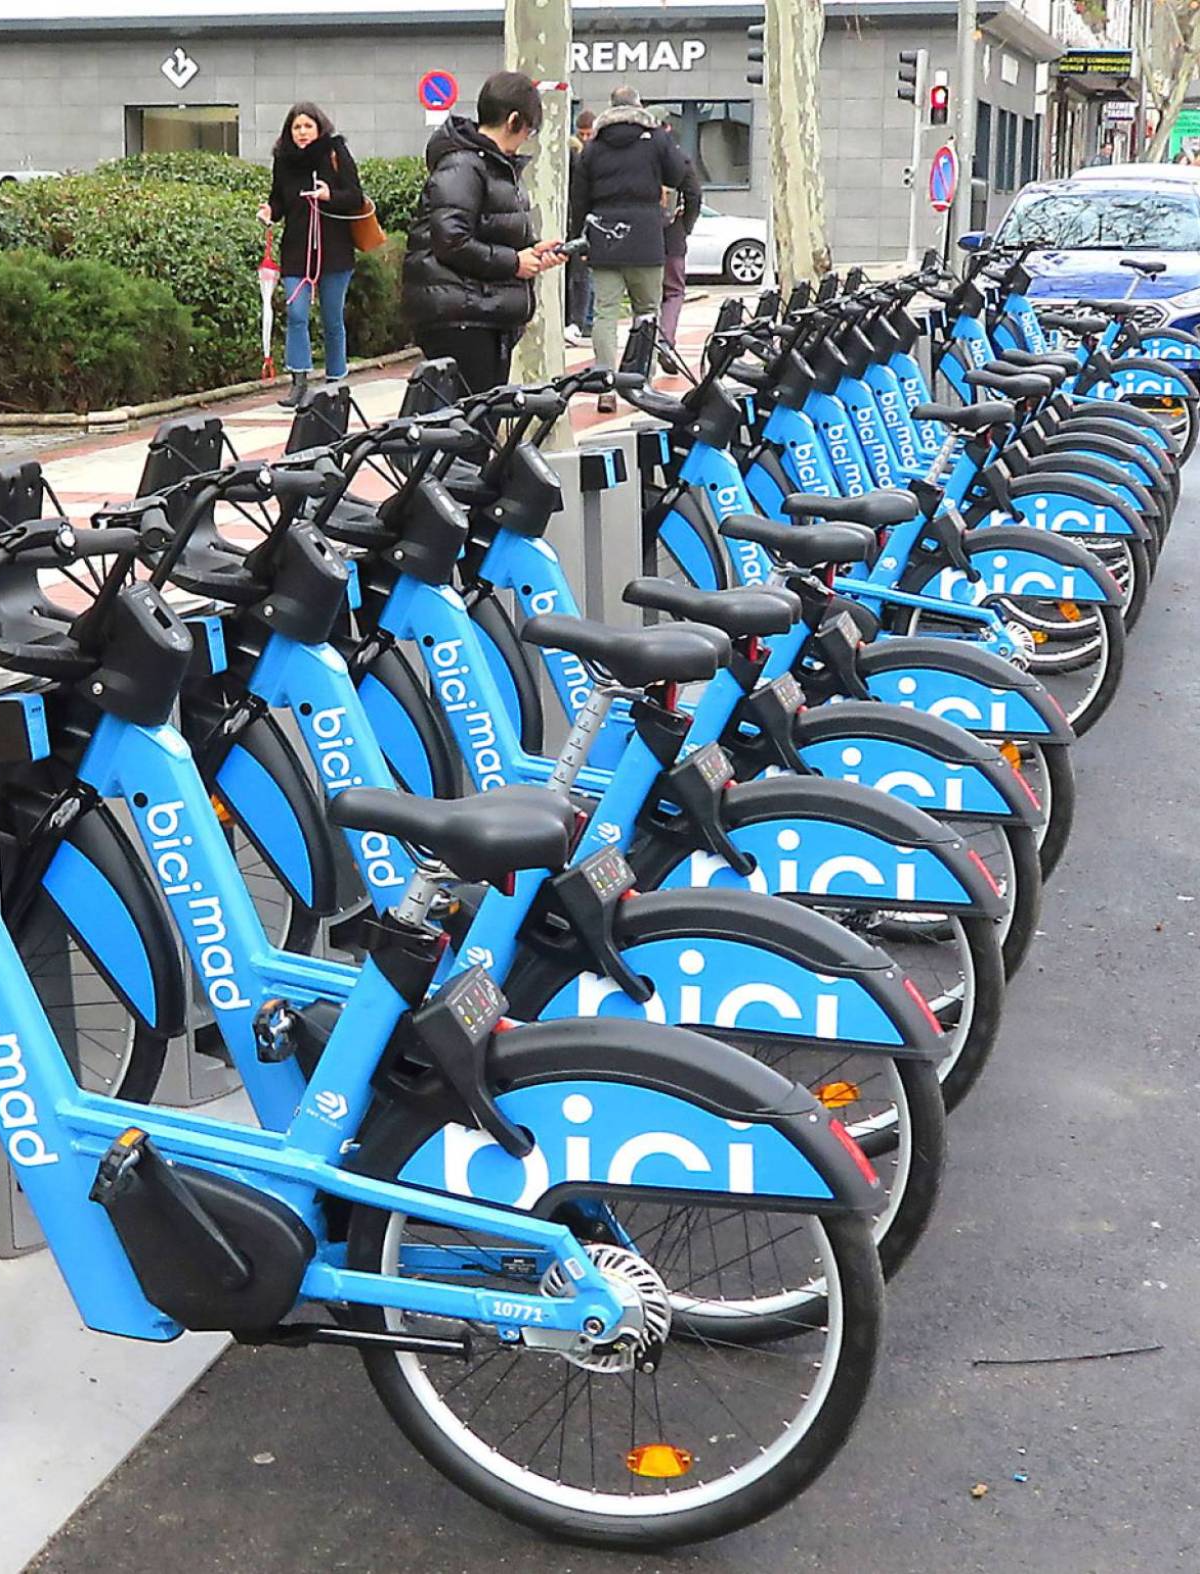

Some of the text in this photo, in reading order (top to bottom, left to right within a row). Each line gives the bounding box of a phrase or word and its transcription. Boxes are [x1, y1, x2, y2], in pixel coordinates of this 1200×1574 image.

[828, 424, 852, 465] bici
[857, 407, 880, 446] bici
[881, 392, 921, 469] bici mad
[795, 443, 821, 487] bici
[432, 639, 478, 713] bici
[312, 706, 405, 888] bici ad
[146, 800, 252, 1010] bici mad
[492, 1301, 544, 1323] 10771
